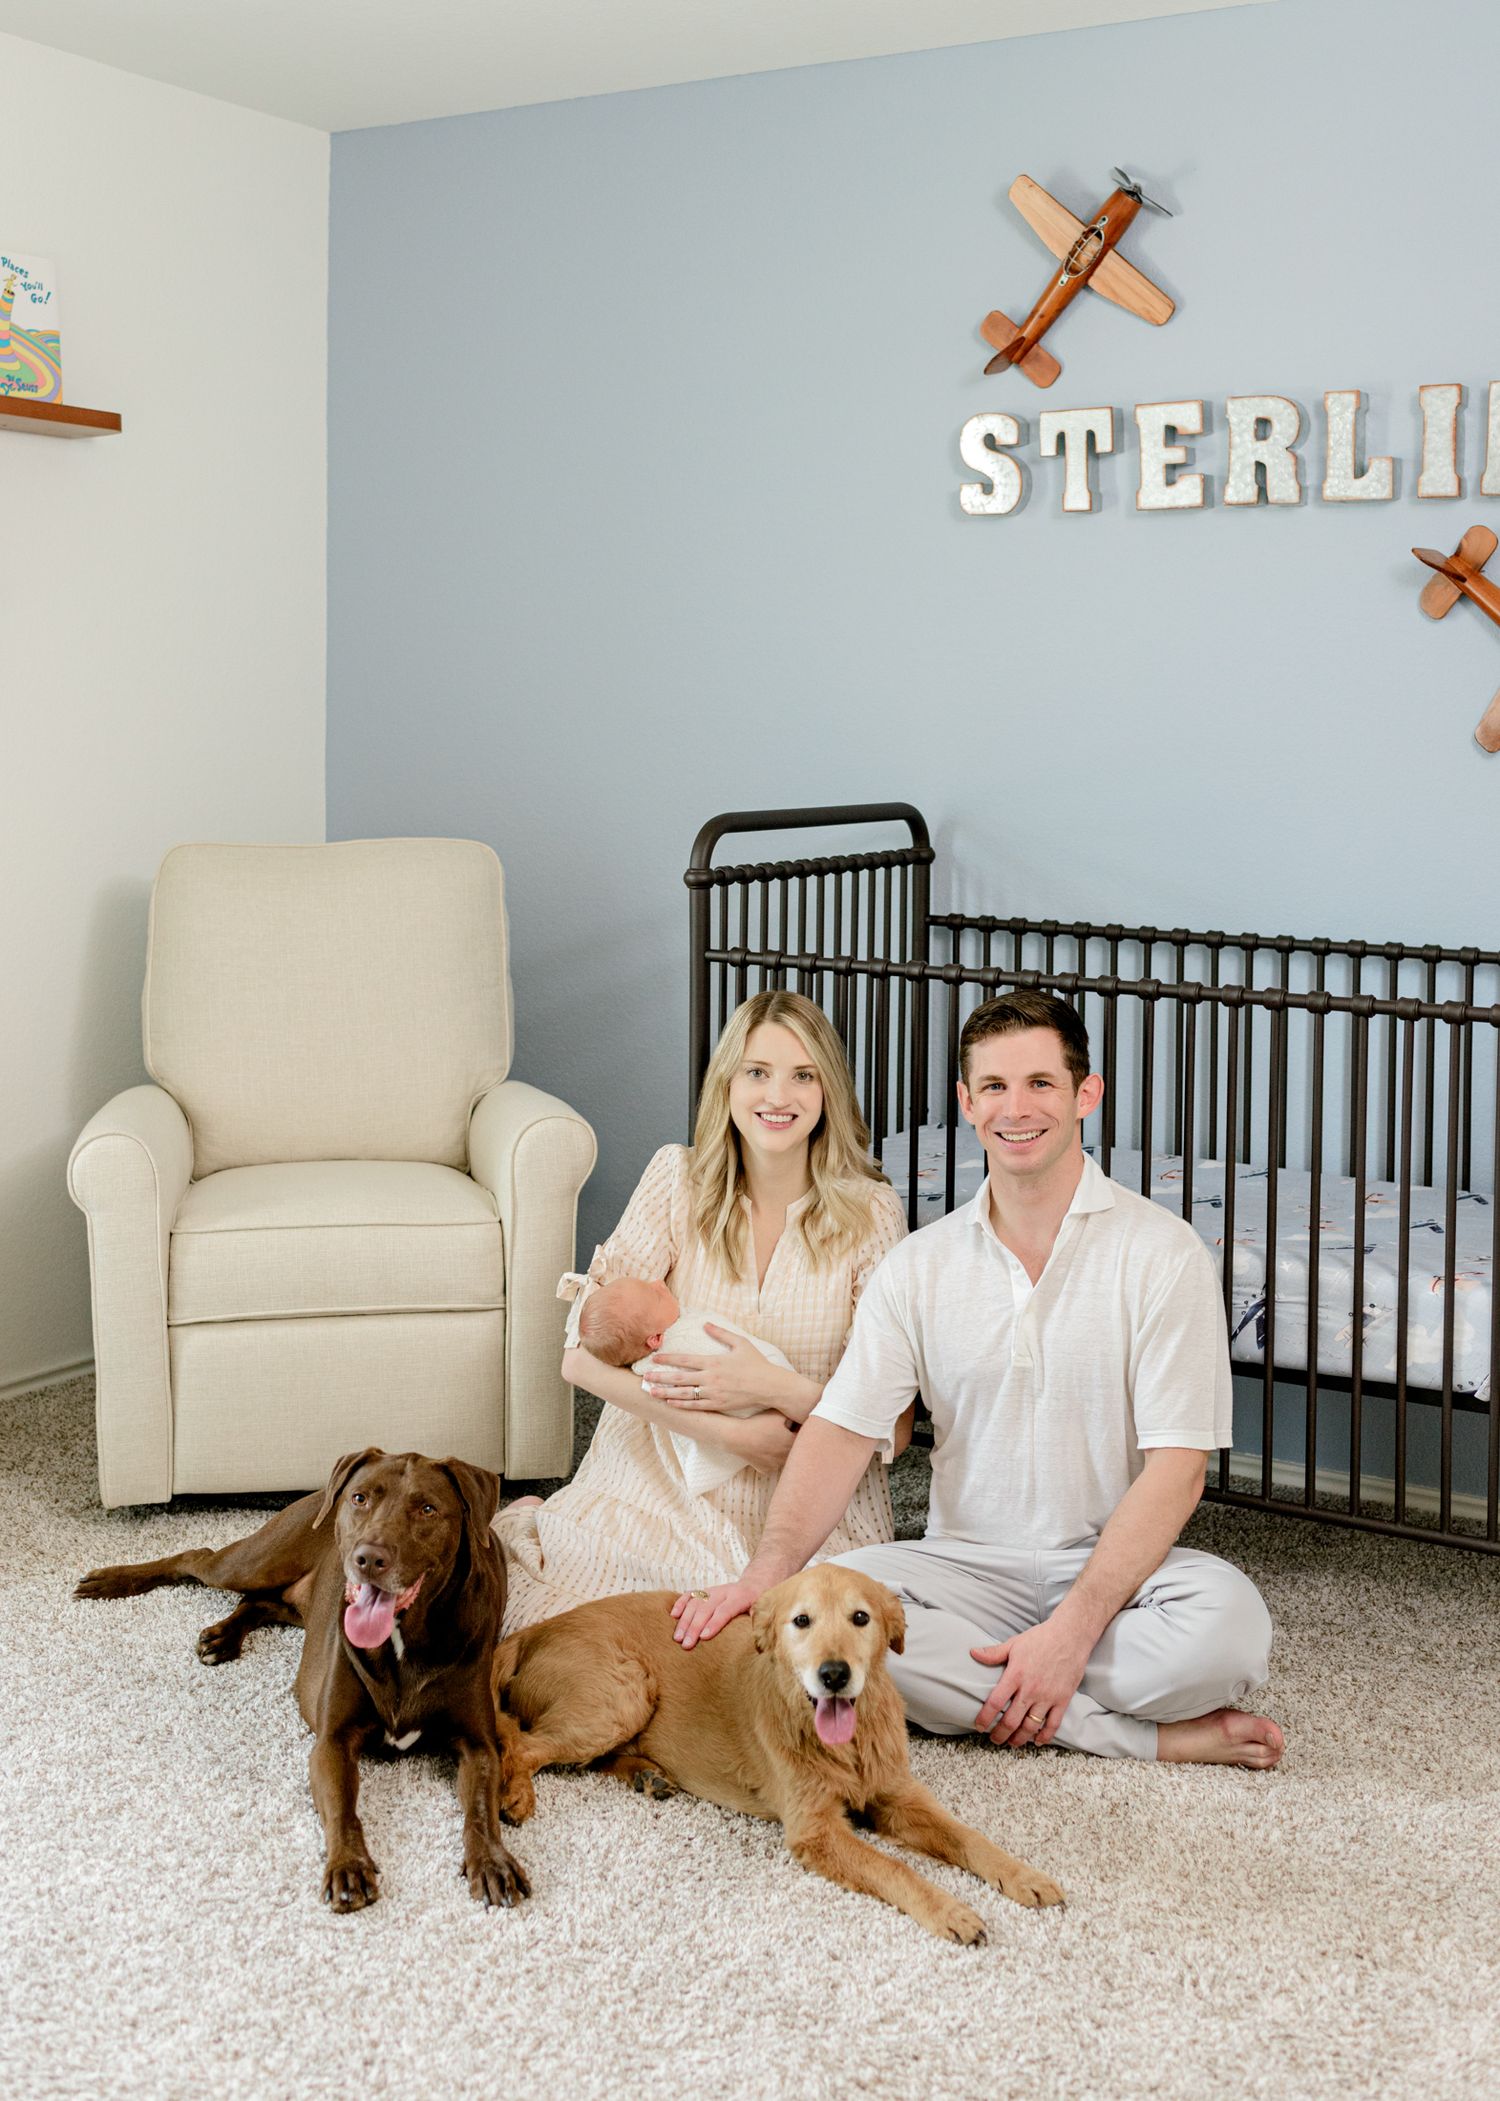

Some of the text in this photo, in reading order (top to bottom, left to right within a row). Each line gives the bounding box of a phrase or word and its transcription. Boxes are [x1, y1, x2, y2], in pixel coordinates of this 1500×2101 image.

[1, 256, 29, 278] Places
[20, 281, 43, 291] You'll
[31, 291, 52, 304] Go!
[959, 381, 1500, 515] STERLI
